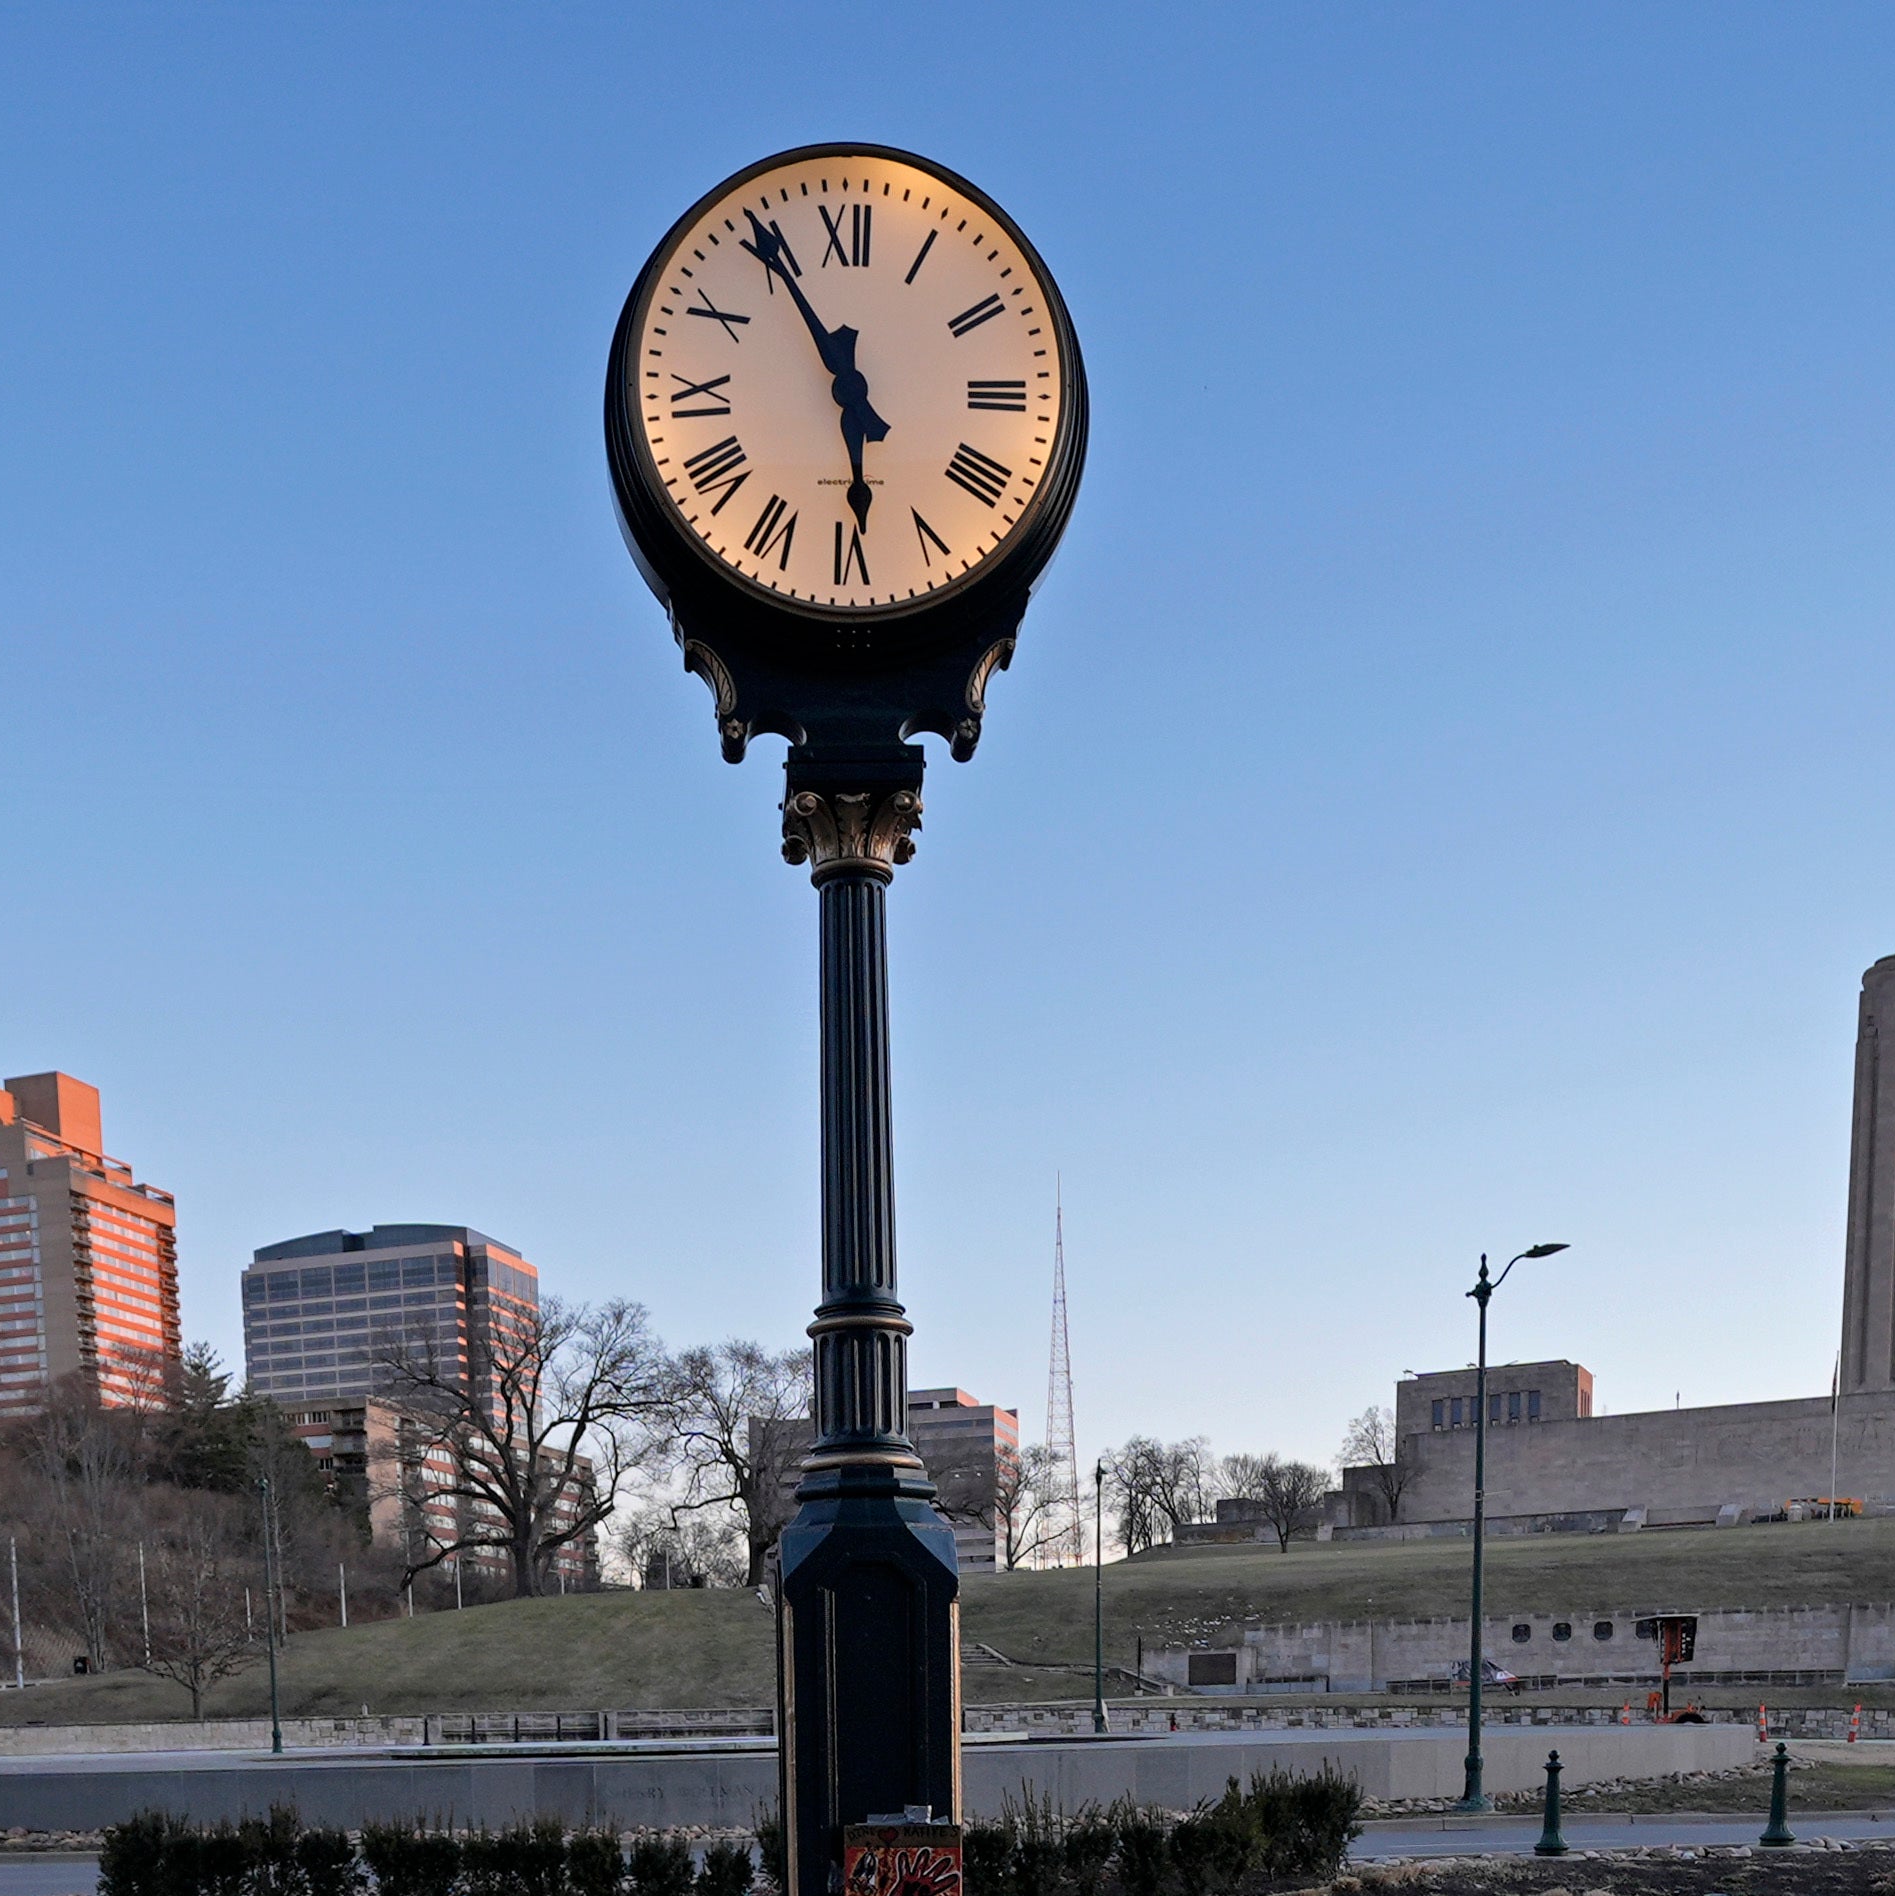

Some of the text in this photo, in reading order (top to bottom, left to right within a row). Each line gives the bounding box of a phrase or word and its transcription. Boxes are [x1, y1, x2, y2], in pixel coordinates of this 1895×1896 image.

[817, 204, 872, 268] XII
[686, 288, 750, 344] X
[947, 292, 1005, 338] II
[670, 373, 731, 419] IX
[968, 380, 1026, 412] III
[683, 435, 754, 517] VIII
[944, 442, 1013, 509] IIII
[743, 494, 800, 572] VII
[833, 521, 871, 586] VI
[910, 506, 951, 568] V
